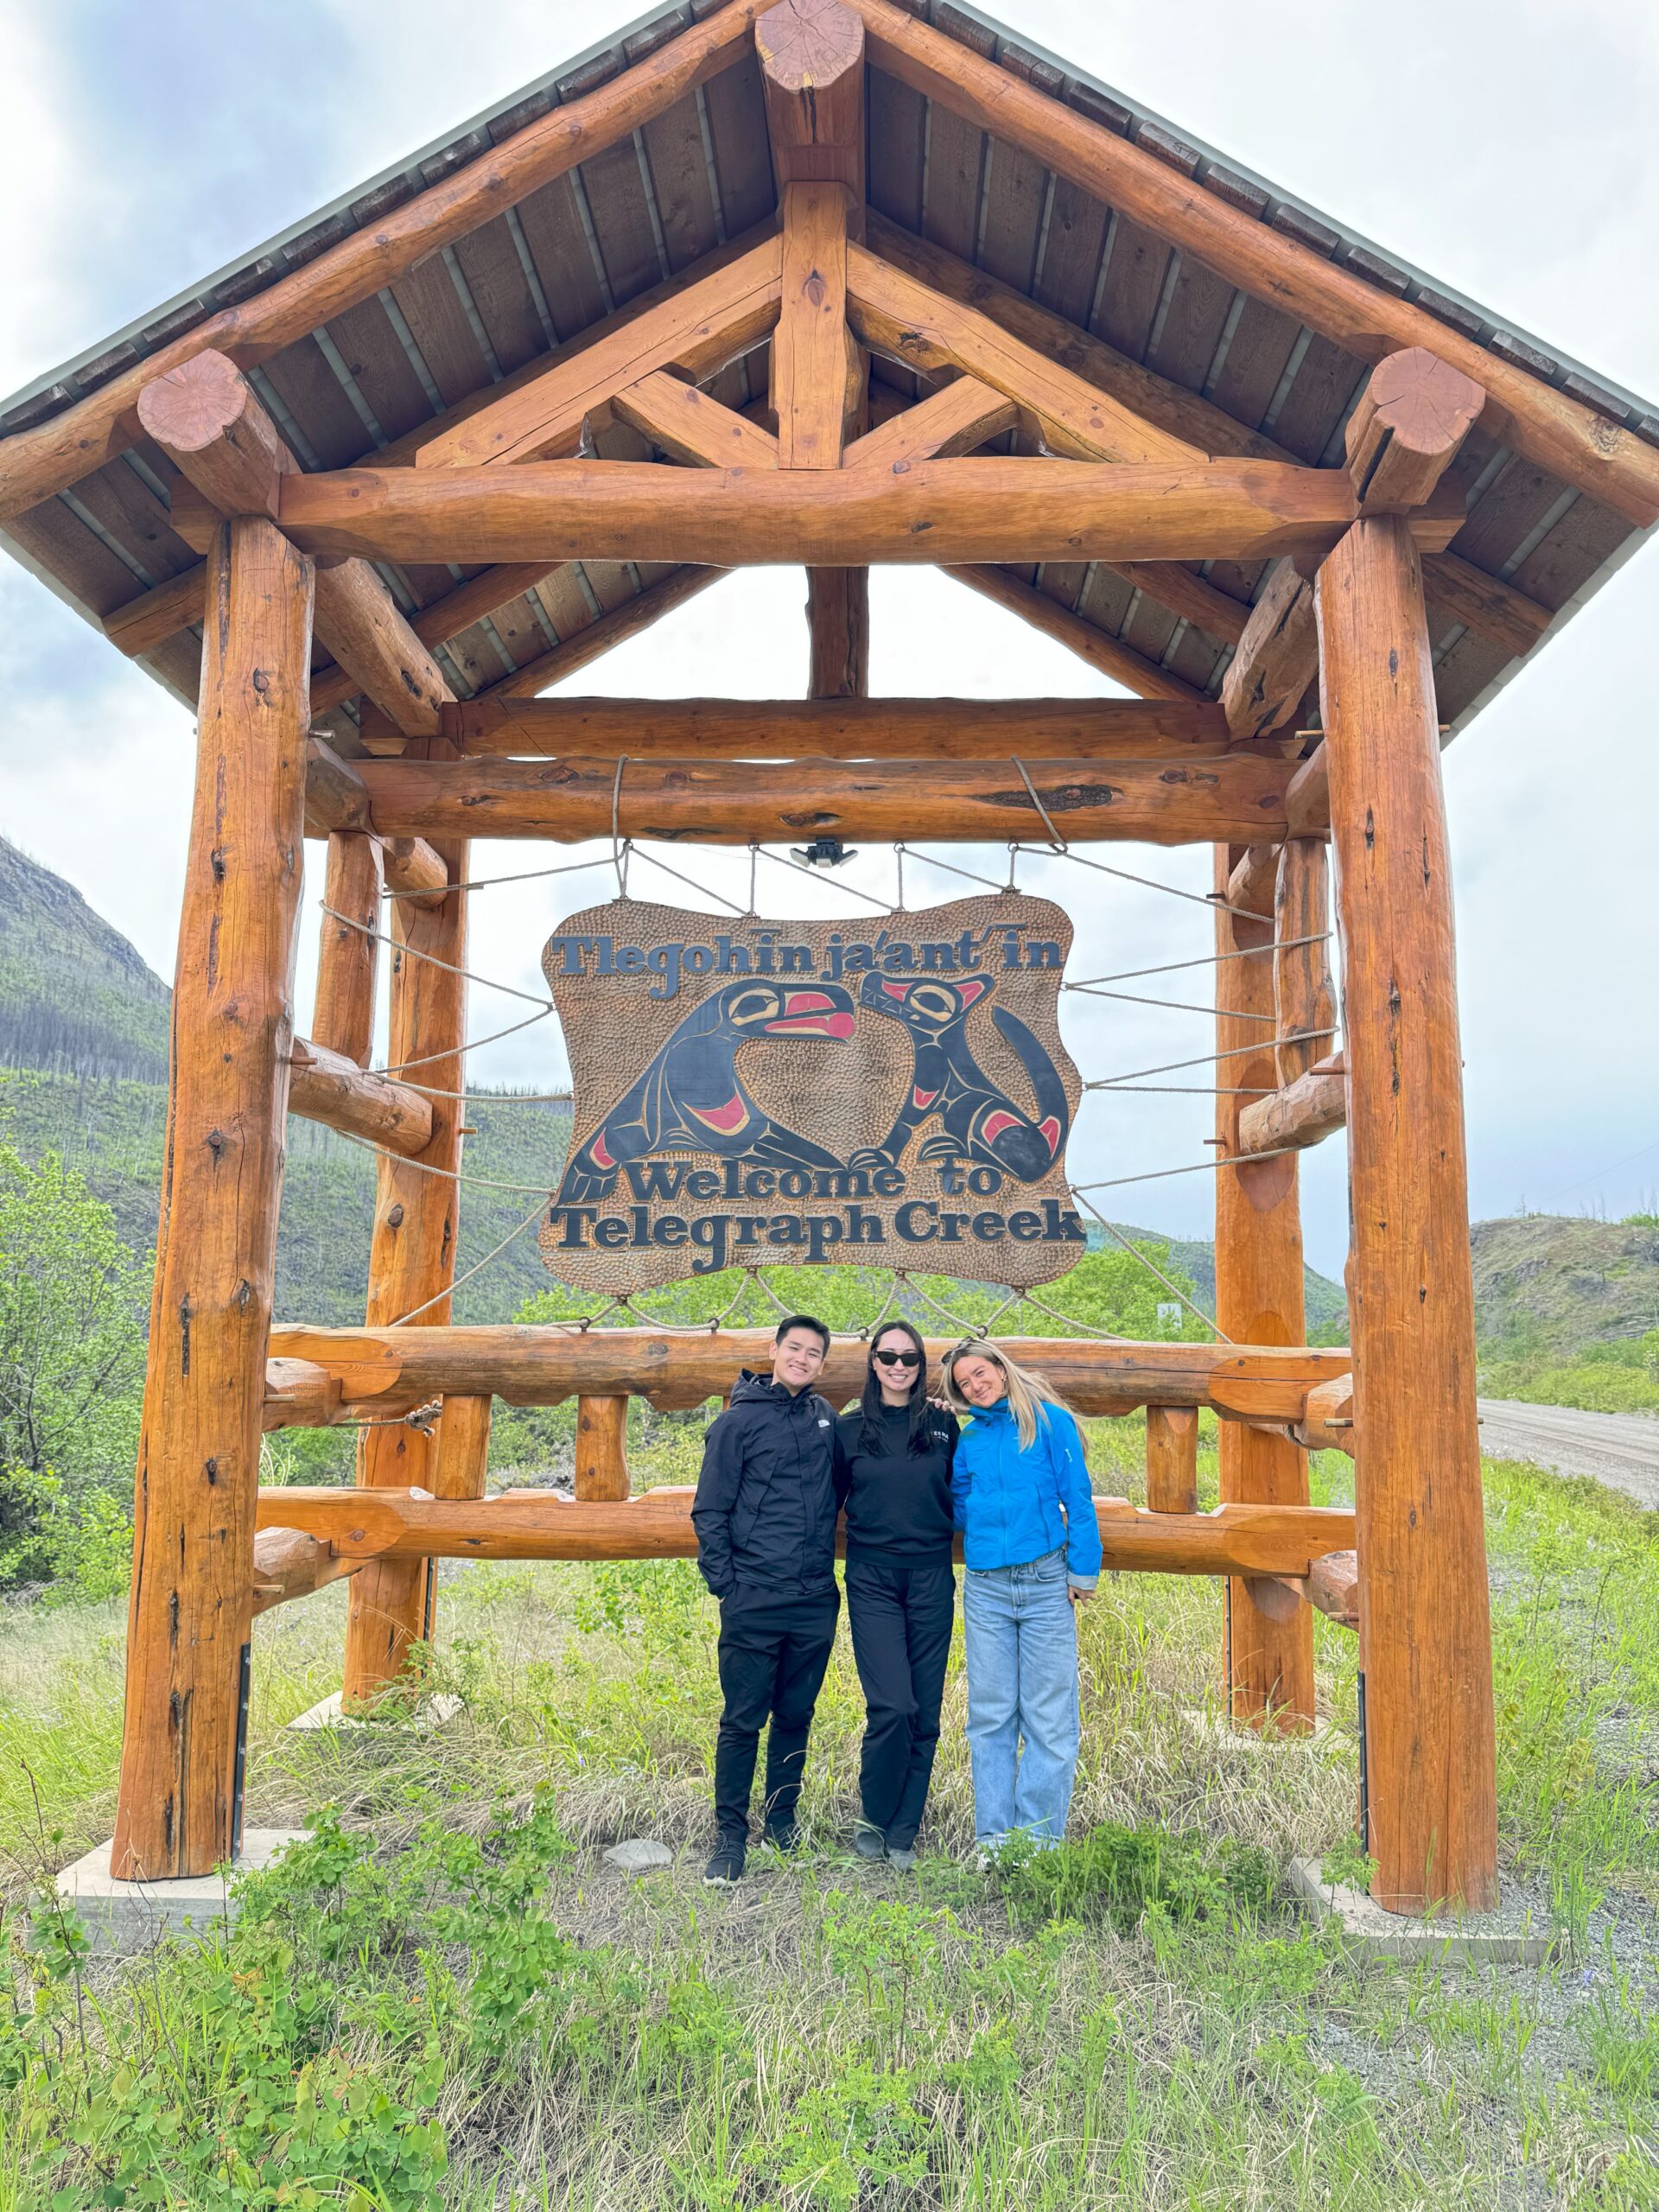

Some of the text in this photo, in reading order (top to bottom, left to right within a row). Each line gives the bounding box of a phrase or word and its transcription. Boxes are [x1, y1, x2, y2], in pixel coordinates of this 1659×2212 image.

[620, 1156, 1002, 1201] Welcome to
[550, 1198, 1088, 1273] Telegraph Creek
